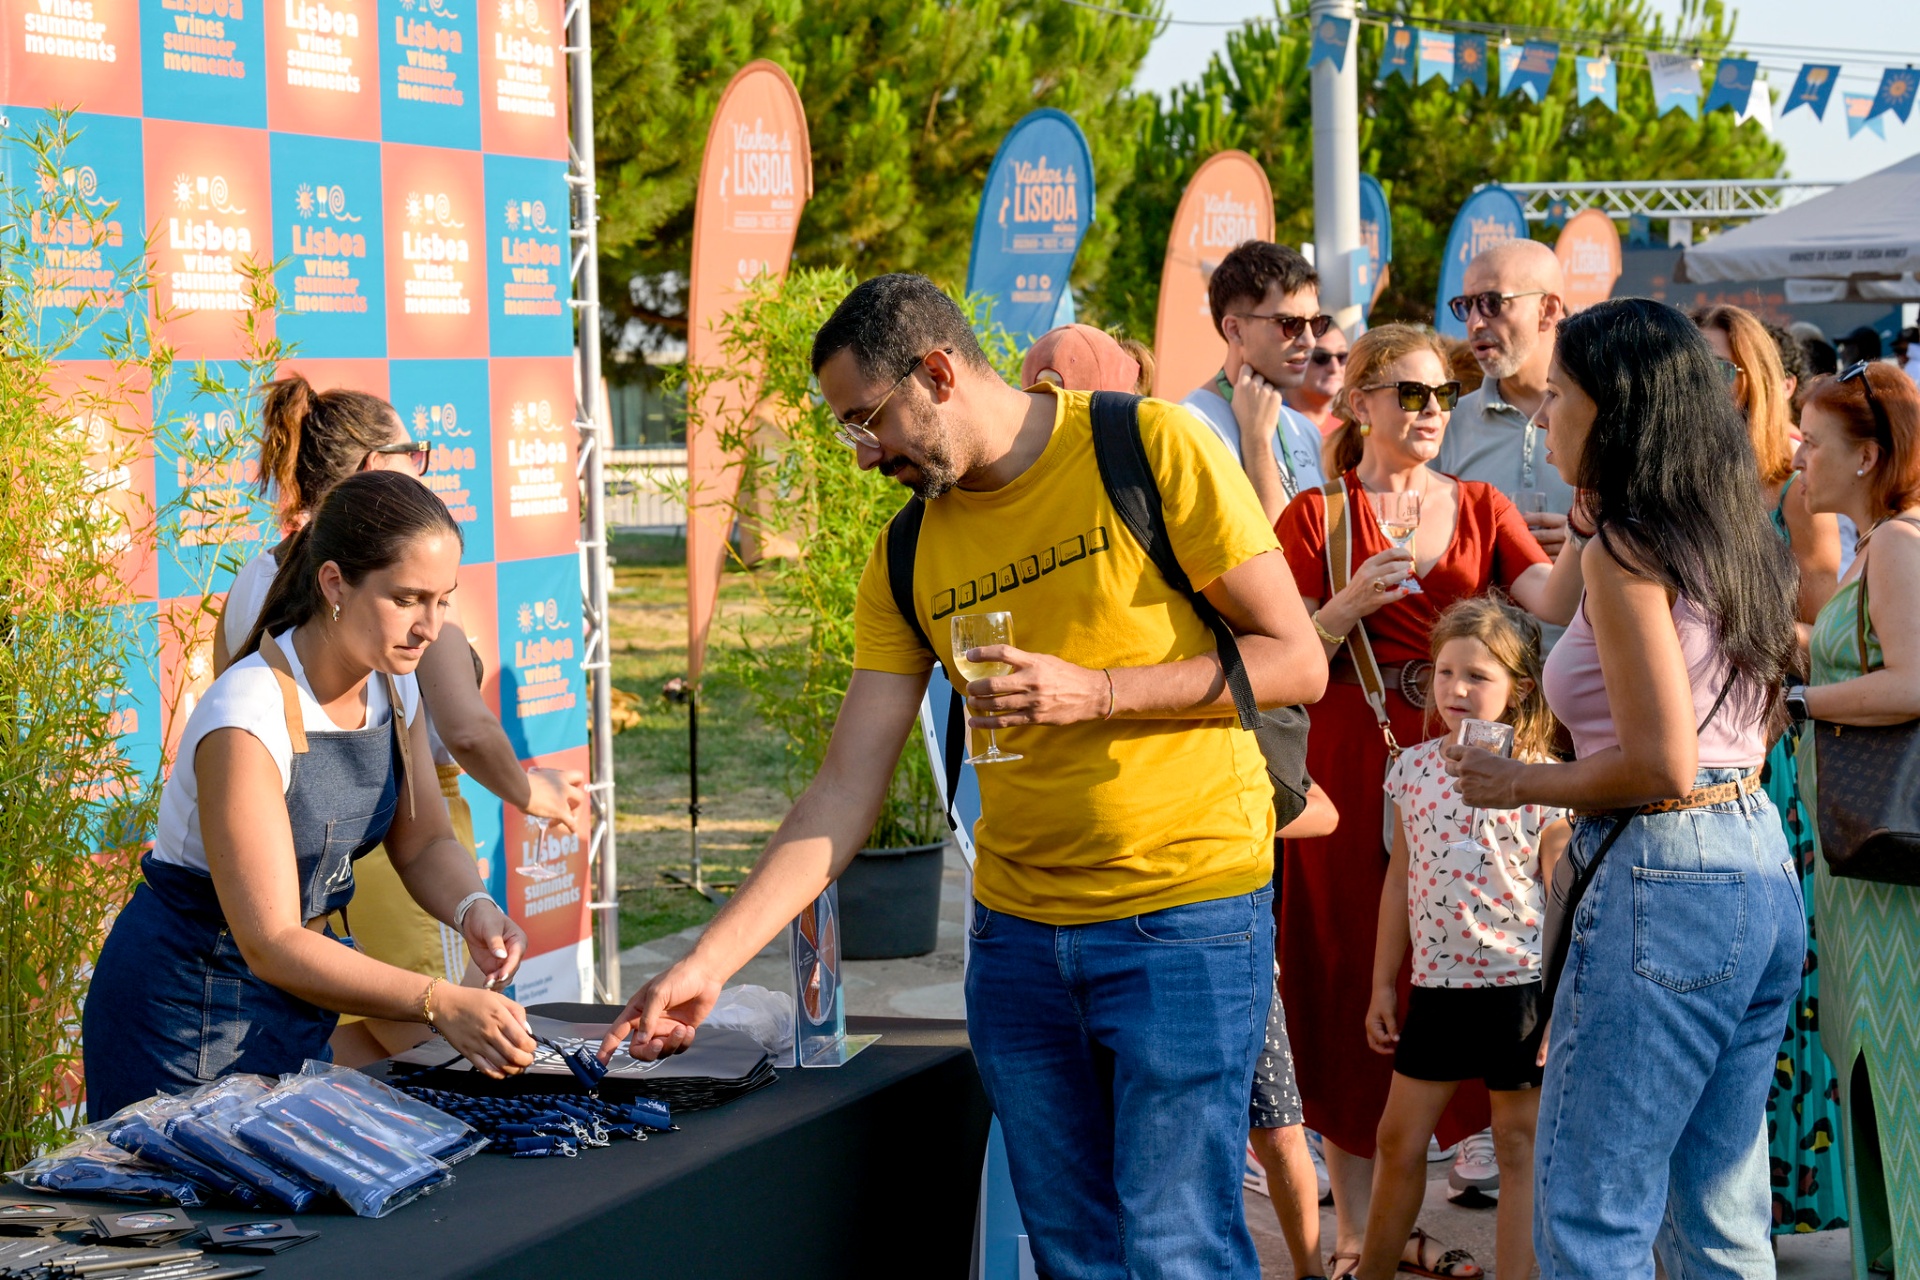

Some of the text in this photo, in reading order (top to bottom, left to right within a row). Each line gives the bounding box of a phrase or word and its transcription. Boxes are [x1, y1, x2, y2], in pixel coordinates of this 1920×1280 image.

[38, 0, 93, 20] wines
[285, 0, 359, 38] Lisboa
[25, 13, 106, 41] summer
[174, 14, 225, 39] wines
[395, 16, 463, 53] Lisboa
[25, 33, 117, 62] moments
[163, 32, 236, 58] summer
[296, 32, 342, 55] wines
[495, 32, 554, 68] Lisboa
[163, 51, 246, 79] moments
[287, 49, 352, 73] summer
[406, 49, 447, 71] wines
[287, 67, 361, 94] moments
[397, 65, 456, 88] summer
[505, 63, 543, 84] wines
[397, 82, 464, 106] moments
[497, 78, 551, 100] summer
[497, 95, 556, 117] moments
[733, 117, 779, 151] Vinhos
[733, 153, 794, 196] LISBOA
[1014, 155, 1064, 185] Vinhos
[1014, 185, 1078, 223] LISBOA
[31, 210, 124, 247] Lisboa
[169, 218, 251, 253] Lisboa
[1203, 214, 1258, 247] LISBOA
[292, 224, 367, 258] Lisboa
[402, 230, 470, 262] Lisboa
[501, 236, 561, 267] Lisboa
[45, 246, 102, 269] wines
[182, 251, 233, 273] wines
[304, 256, 349, 277] wines
[32, 267, 115, 288] summer
[172, 271, 245, 292] summer
[413, 261, 454, 281] wines
[511, 264, 549, 284] wines
[294, 275, 360, 295] summer
[404, 279, 464, 299] summer
[503, 282, 557, 299] summer
[172, 290, 254, 311] moments
[294, 293, 368, 313] moments
[404, 296, 471, 316] moments
[504, 299, 562, 316] moments
[508, 437, 568, 467] Lisboa
[518, 466, 555, 484] wines
[509, 482, 563, 500] summer
[510, 497, 568, 518] moments
[515, 637, 574, 668] Lisboa
[524, 663, 562, 684] wines
[517, 678, 569, 702] summer
[517, 693, 576, 718] moments
[524, 873, 575, 901] summer
[525, 886, 580, 917] moments
